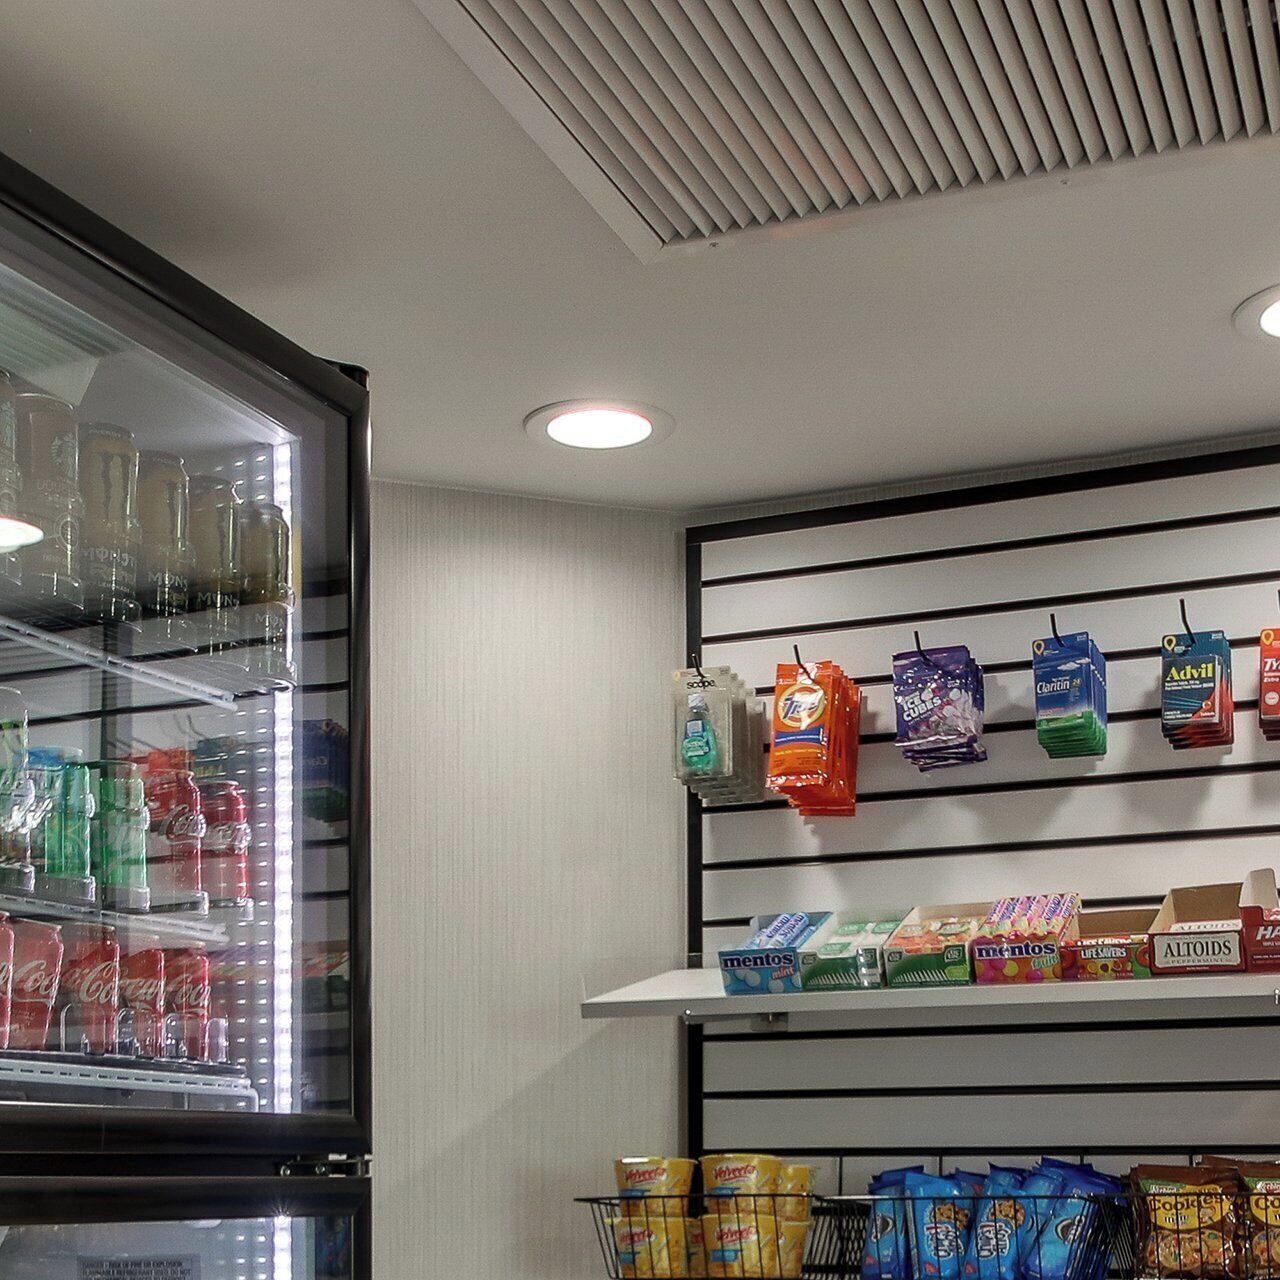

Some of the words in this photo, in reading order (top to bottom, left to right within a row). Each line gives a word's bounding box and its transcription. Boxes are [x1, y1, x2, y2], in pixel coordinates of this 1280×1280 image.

[1166, 662, 1214, 682] Advil
[686, 679, 716, 690] scope
[1036, 677, 1070, 693] Claritin
[899, 694, 922, 713] ICE
[903, 696, 942, 723] CUBES
[1175, 922, 1240, 932] ALTOIDS
[976, 943, 1057, 959] mentos
[1163, 940, 1232, 958] ALTOIDS
[722, 953, 794, 968] mentos
[772, 966, 795, 980] mint
[713, 1164, 757, 1180] Velveeta
